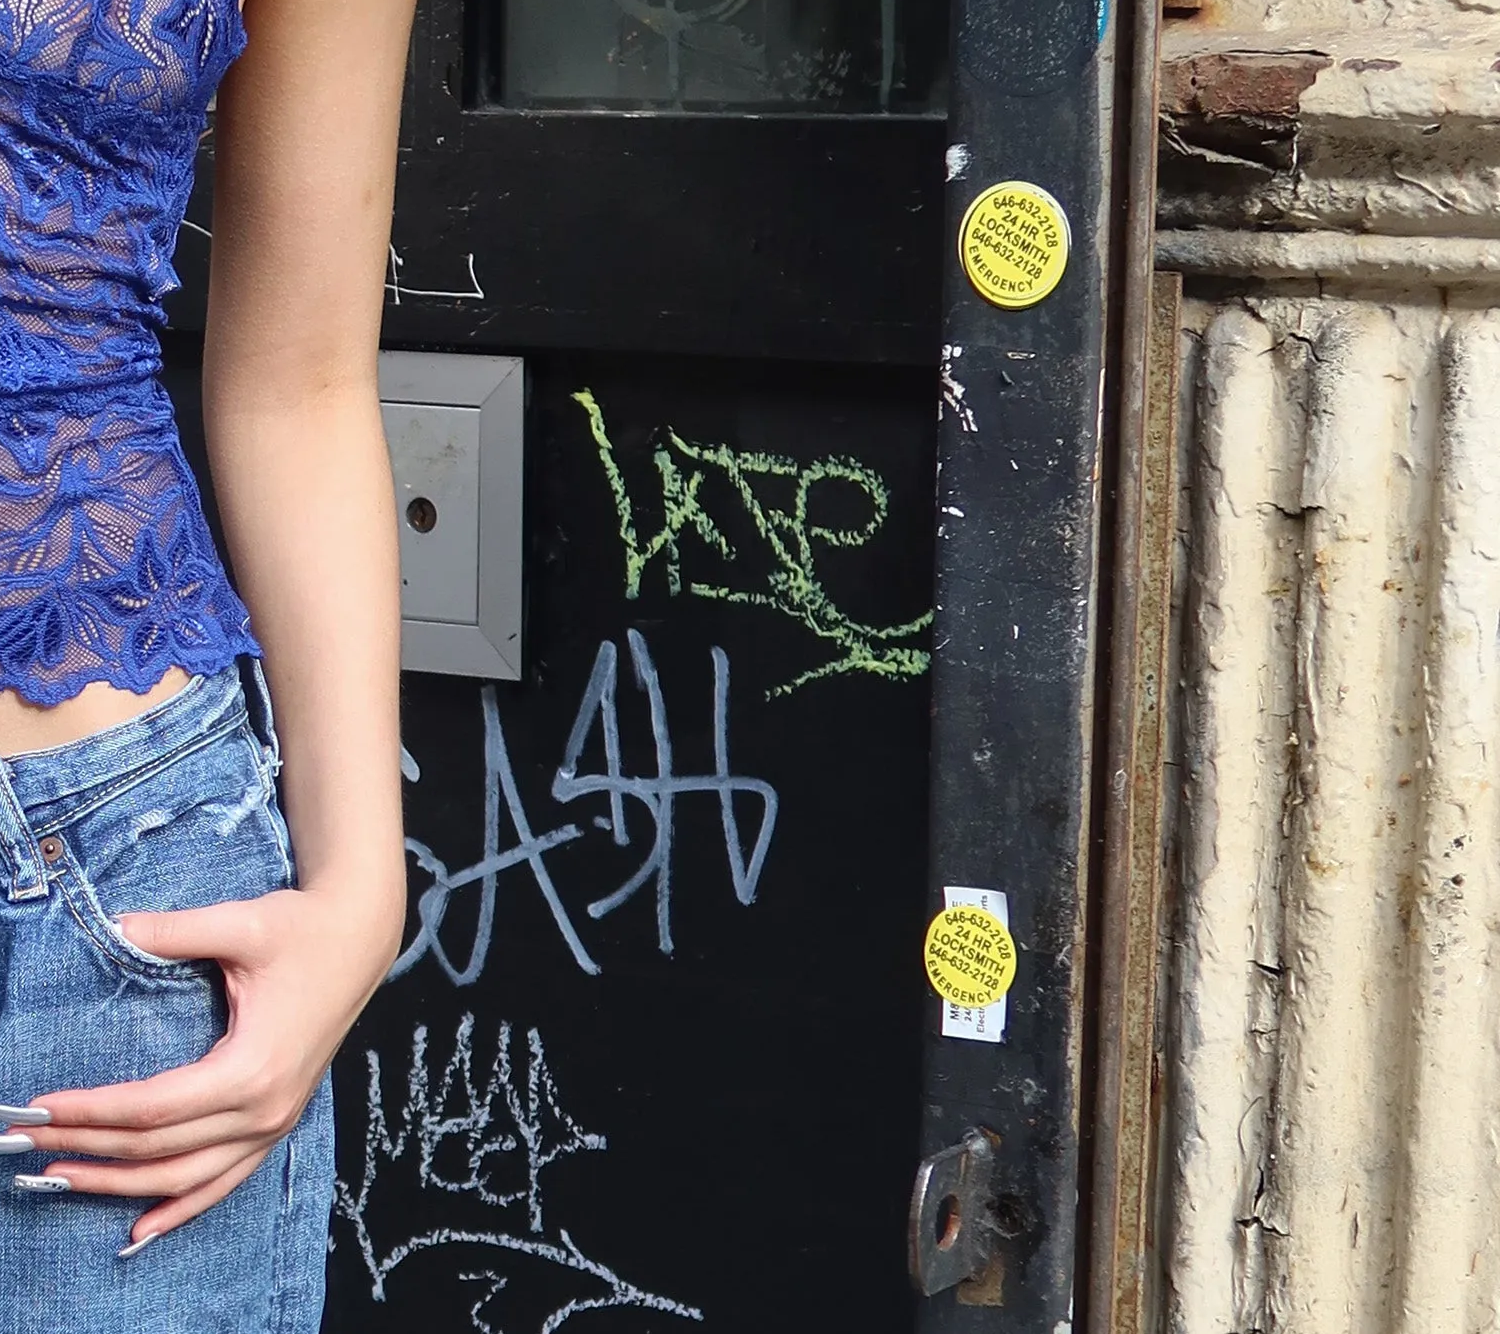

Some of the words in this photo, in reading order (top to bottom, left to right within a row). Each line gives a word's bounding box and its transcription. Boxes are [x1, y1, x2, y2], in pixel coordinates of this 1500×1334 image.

[978, 212, 1051, 266] LOCKSMITH
[993, 195, 1059, 248] 646-632-2128
[1001, 210, 1019, 227] 24
[1020, 220, 1040, 241] HR
[968, 245, 1034, 293] EMERGENCY
[971, 227, 1043, 279] 646-632-2128
[933, 928, 1006, 977] LOCKSMITH
[944, 911, 1012, 960] 646-632-2128
[955, 925, 971, 941] 24
[972, 934, 992, 954] HR
[927, 960, 992, 1004] EMERGENCY
[928, 942, 1000, 991] 646-632-2128
